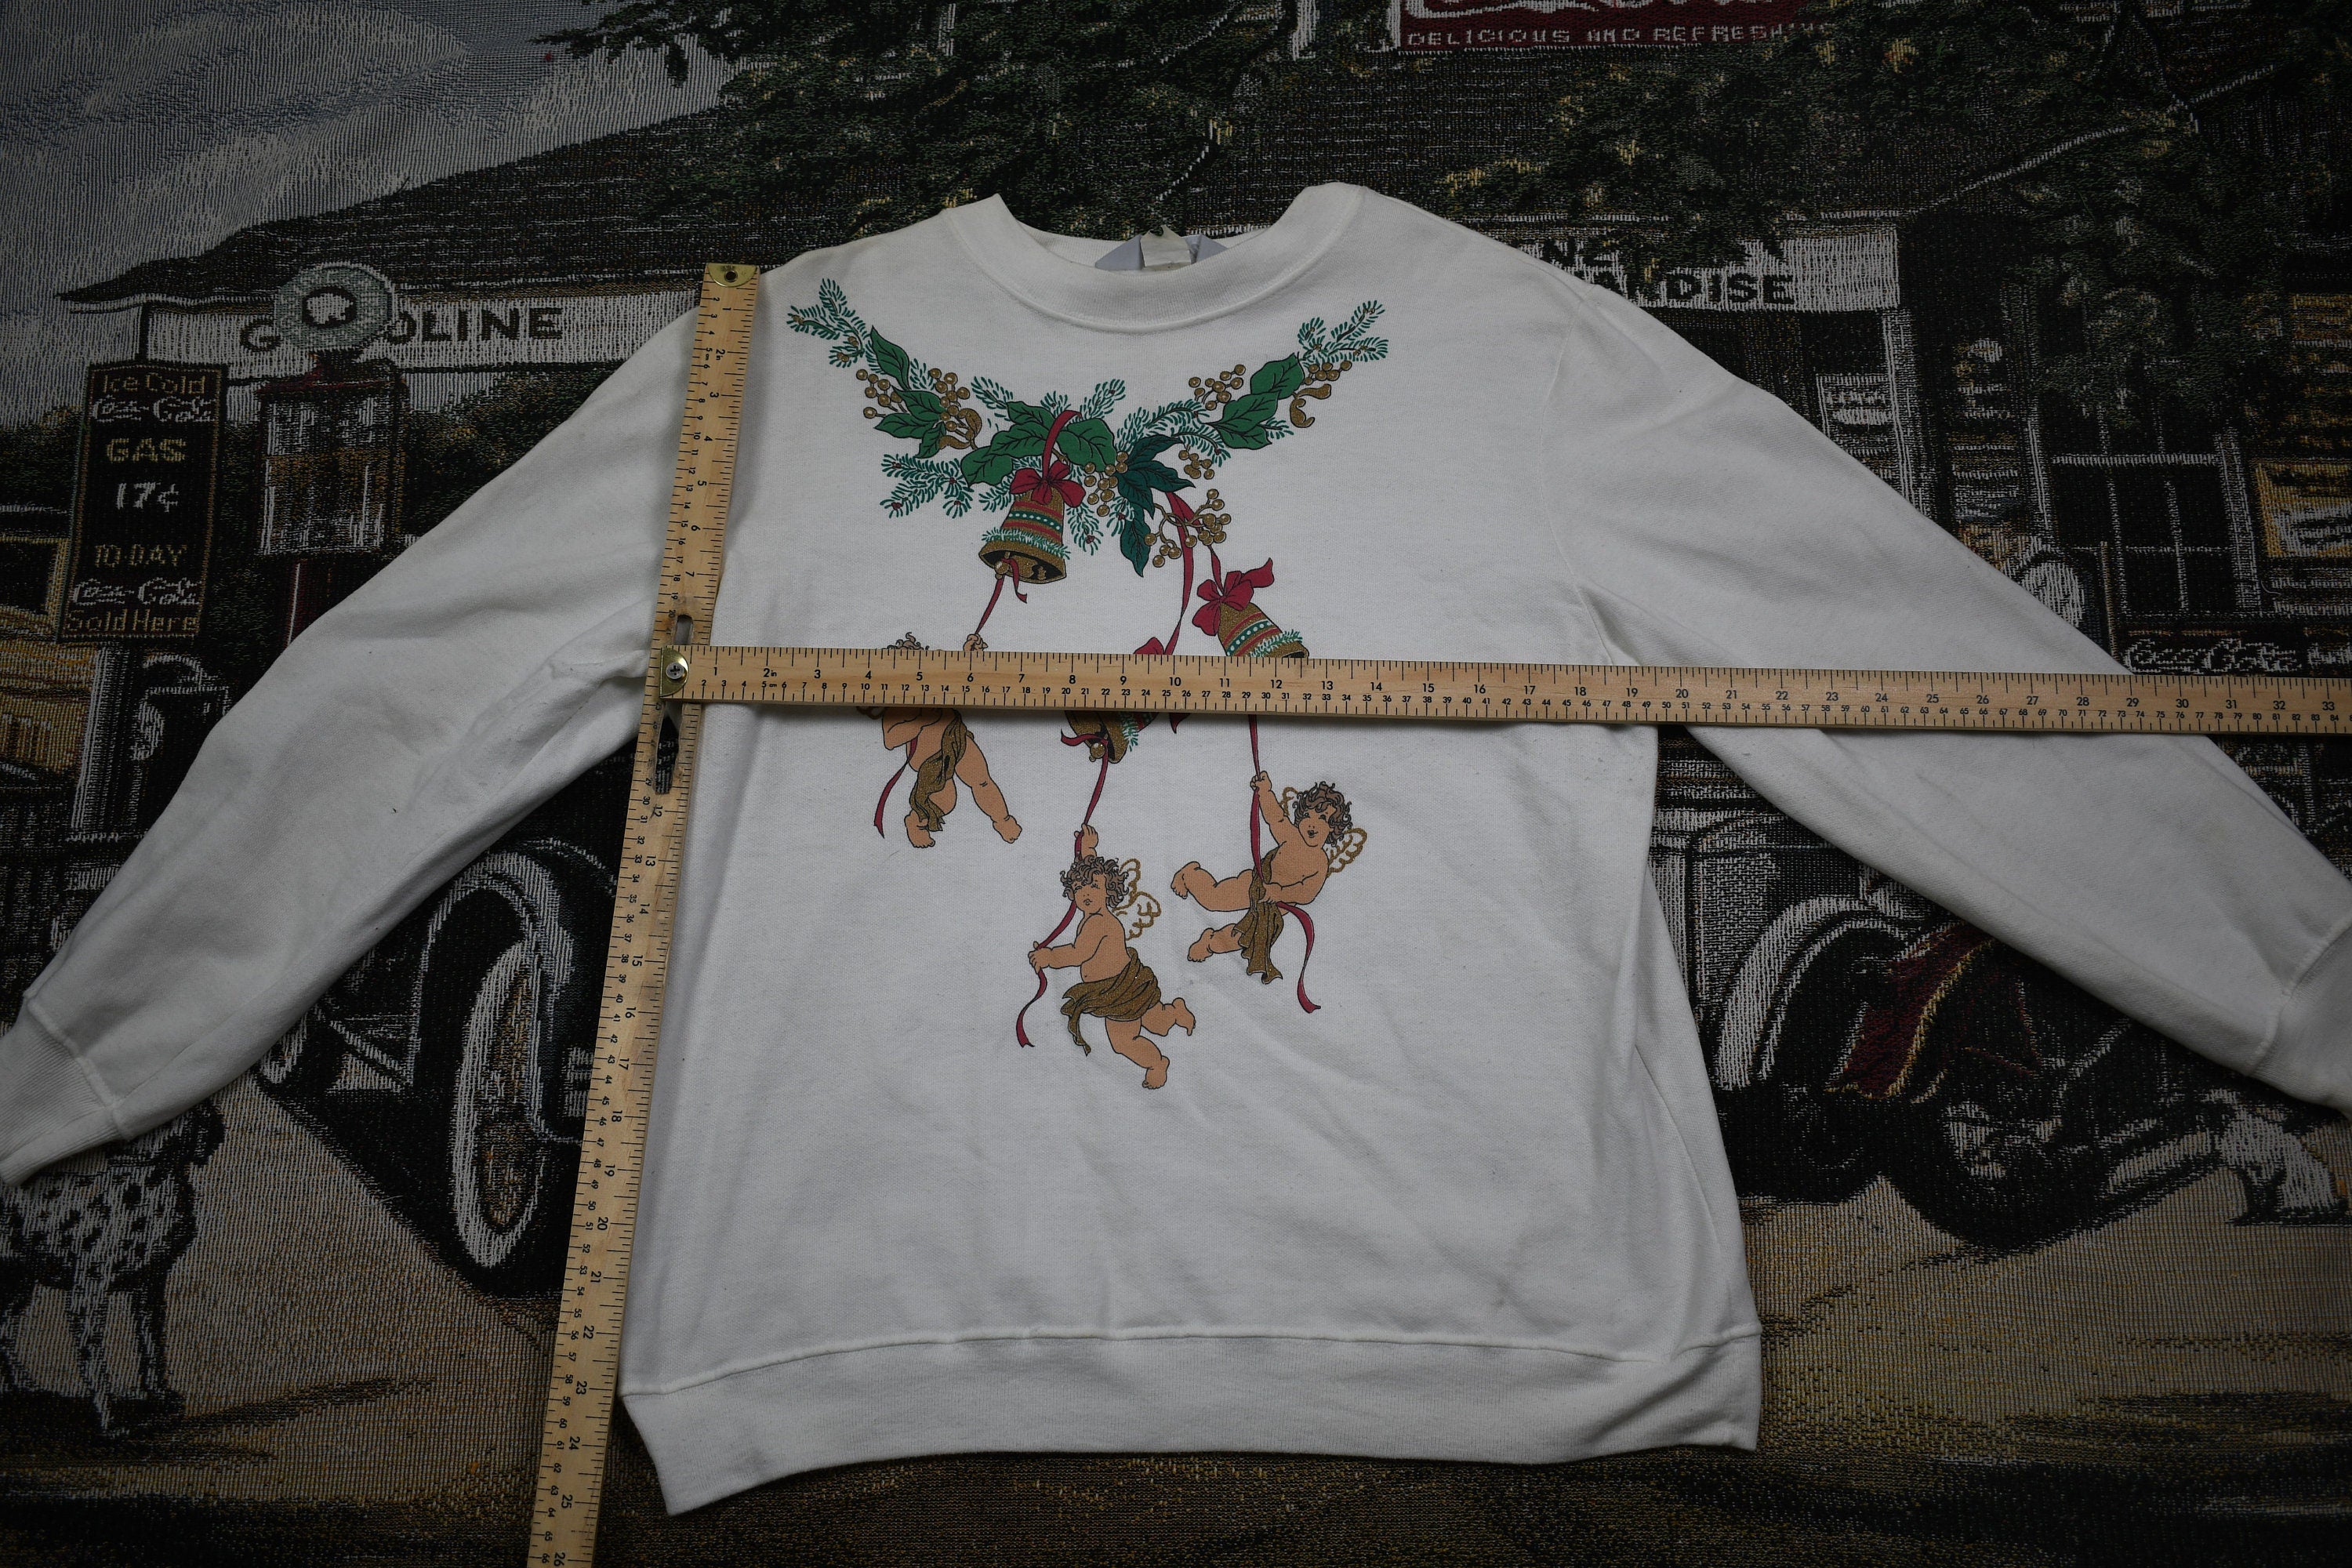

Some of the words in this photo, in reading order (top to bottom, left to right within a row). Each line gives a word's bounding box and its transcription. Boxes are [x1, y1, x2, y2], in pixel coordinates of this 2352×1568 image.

[1407, 29, 1570, 45] DELICIOUS
[1586, 27, 1640, 43] AND
[239, 307, 563, 353] GOLINE
[103, 375, 139, 393] Ice
[145, 372, 207, 394] Cold
[692, 431, 702, 441] 10
[106, 437, 188, 463] GAS
[688, 466, 696, 475] 12
[117, 481, 180, 514] 17¢
[66, 608, 129, 632] Sold
[132, 608, 198, 632] Here
[763, 667, 771, 677] 2
[814, 669, 821, 679] 3
[864, 670, 873, 680] 4
[916, 671, 924, 681] 5
[967, 672, 974, 683] 6
[1018, 673, 1025, 684] 7
[1069, 674, 1076, 684] 8
[1120, 675, 1127, 686] 9
[1169, 677, 1181, 687] 10
[1219, 677, 1230, 688] 11
[1270, 679, 1283, 689] 12
[1320, 681, 1334, 691] 13
[1370, 681, 1383, 691] 14
[1422, 683, 1435, 693] 15
[1473, 684, 1486, 694] 16
[1523, 685, 1536, 695] 17
[1574, 686, 1587, 696] 18
[1626, 688, 1639, 698] 19
[1675, 688, 1689, 699] 20
[1726, 689, 1737, 699] 21
[1775, 690, 1788, 700] 22
[1825, 691, 1838, 702] 23
[1875, 692, 1889, 702] 24
[1926, 693, 1940, 704] 25
[1976, 695, 1990, 705] 26
[2026, 695, 2039, 706] 27
[2076, 696, 2090, 706] 28
[2125, 697, 2140, 707] 29
[2176, 698, 2190, 709] 30
[2225, 699, 2237, 710] 31
[2273, 700, 2286, 710] 32
[2321, 701, 2336, 711] 33
[642, 796, 651, 806] 30
[652, 805, 663, 818] 12
[637, 835, 645, 845] 32
[645, 855, 657, 867] 13
[632, 873, 641, 883] 34
[639, 903, 651, 915] 14
[626, 913, 635, 924] 36
[621, 953, 630, 964] 38
[632, 954, 644, 967] 15
[615, 993, 624, 1004] 40
[625, 1007, 637, 1018] 16
[610, 1033, 619, 1044] 42
[618, 1058, 630, 1071] 17
[604, 1074, 613, 1084] 44
[599, 1116, 608, 1127] 46
[611, 1110, 623, 1123] 18
[593, 1158, 602, 1168] 48
[604, 1164, 615, 1177] 19
[587, 1200, 597, 1211] 50
[597, 1216, 609, 1231] 20
[582, 1243, 591, 1254] 52
[590, 1271, 602, 1283] 21
[576, 1286, 585, 1296] 54
[570, 1330, 579, 1341] 56
[583, 1325, 595, 1340] 22
[564, 1374, 574, 1385] 58
[575, 1380, 588, 1395] 23
[558, 1417, 568, 1428] 60
[568, 1436, 581, 1450] 24
[553, 1462, 562, 1474] 62
[561, 1494, 573, 1509] 25
[547, 1507, 557, 1518] 64
[541, 1552, 550, 1564] 66
[554, 1552, 566, 1567] 26
